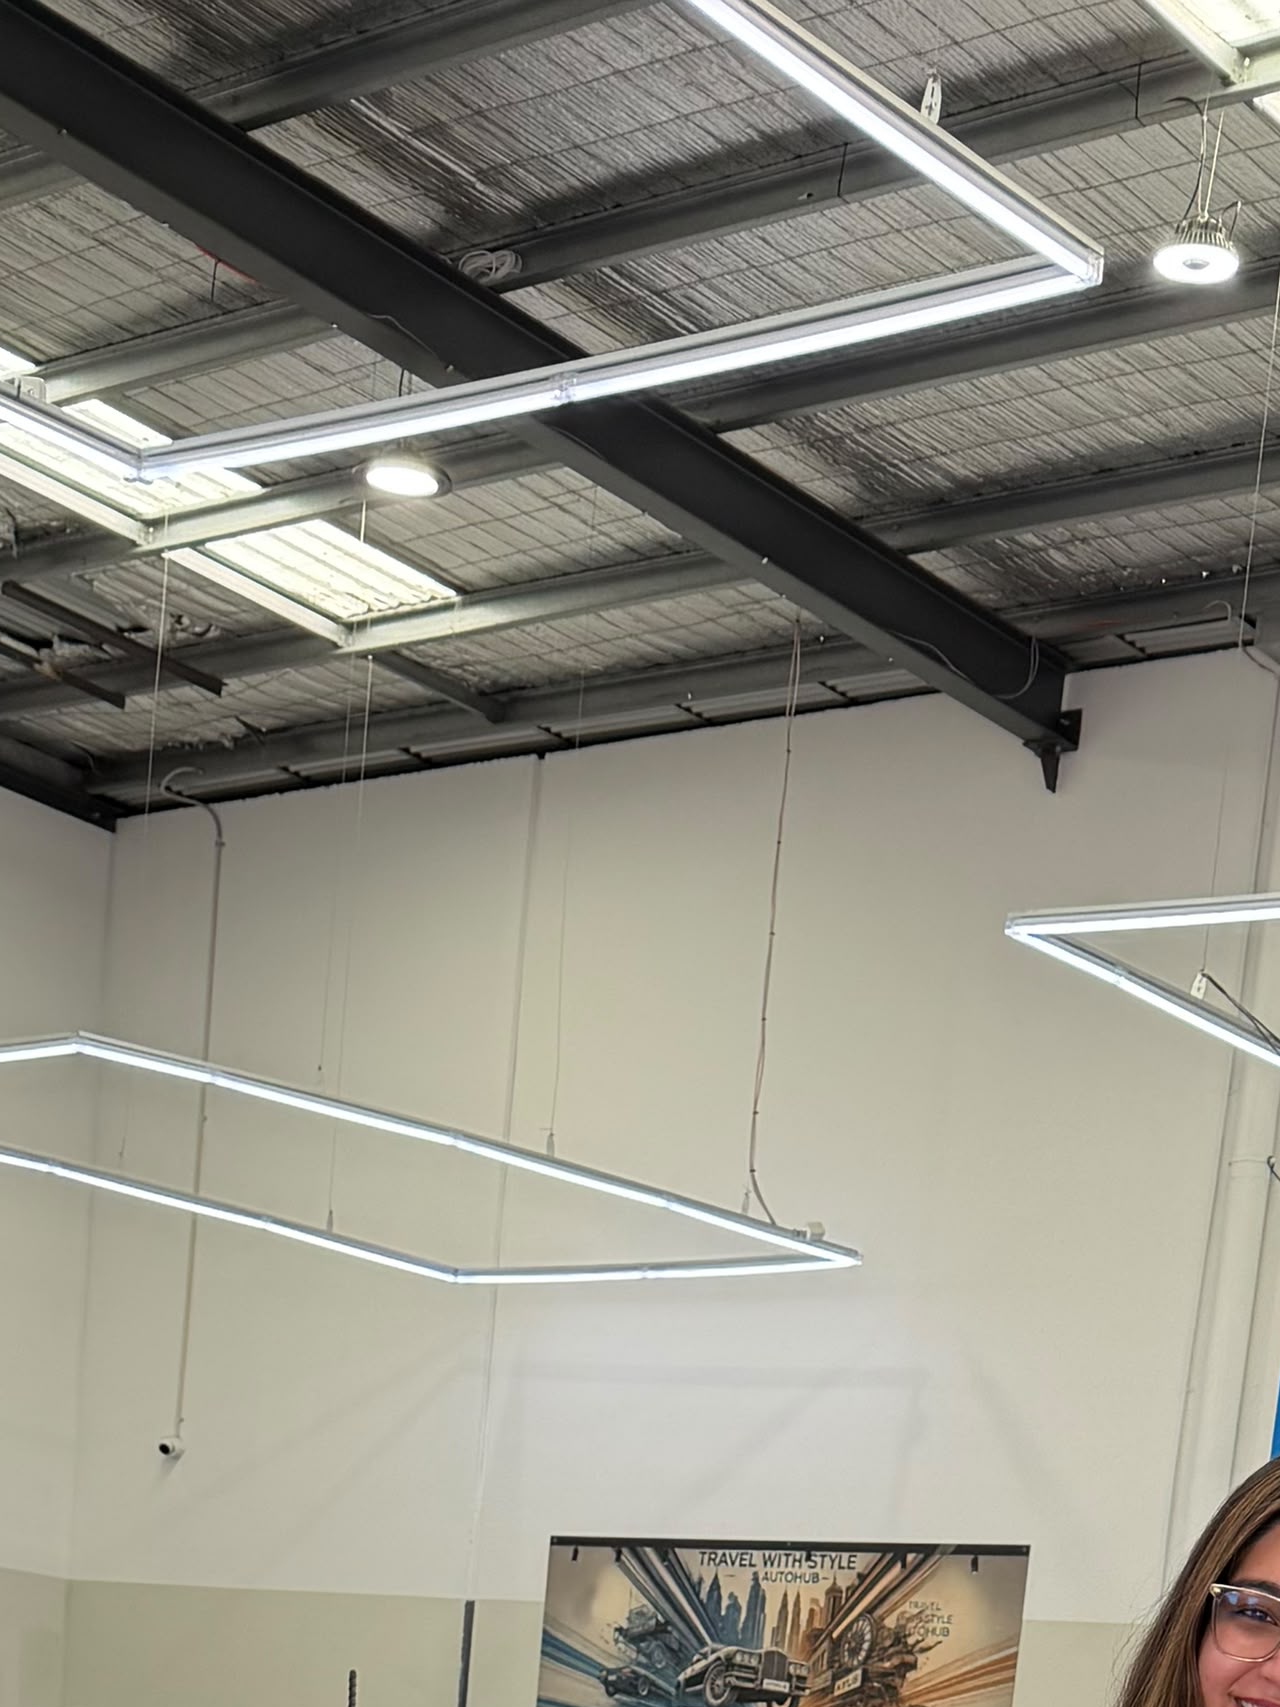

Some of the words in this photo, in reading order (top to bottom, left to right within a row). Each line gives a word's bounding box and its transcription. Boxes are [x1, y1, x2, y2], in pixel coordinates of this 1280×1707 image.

[699, 1552, 757, 1567] TRAVEL
[762, 1553, 802, 1568] WITH
[807, 1554, 857, 1570] STYLE
[762, 1571, 820, 1584] AUTOHUB
